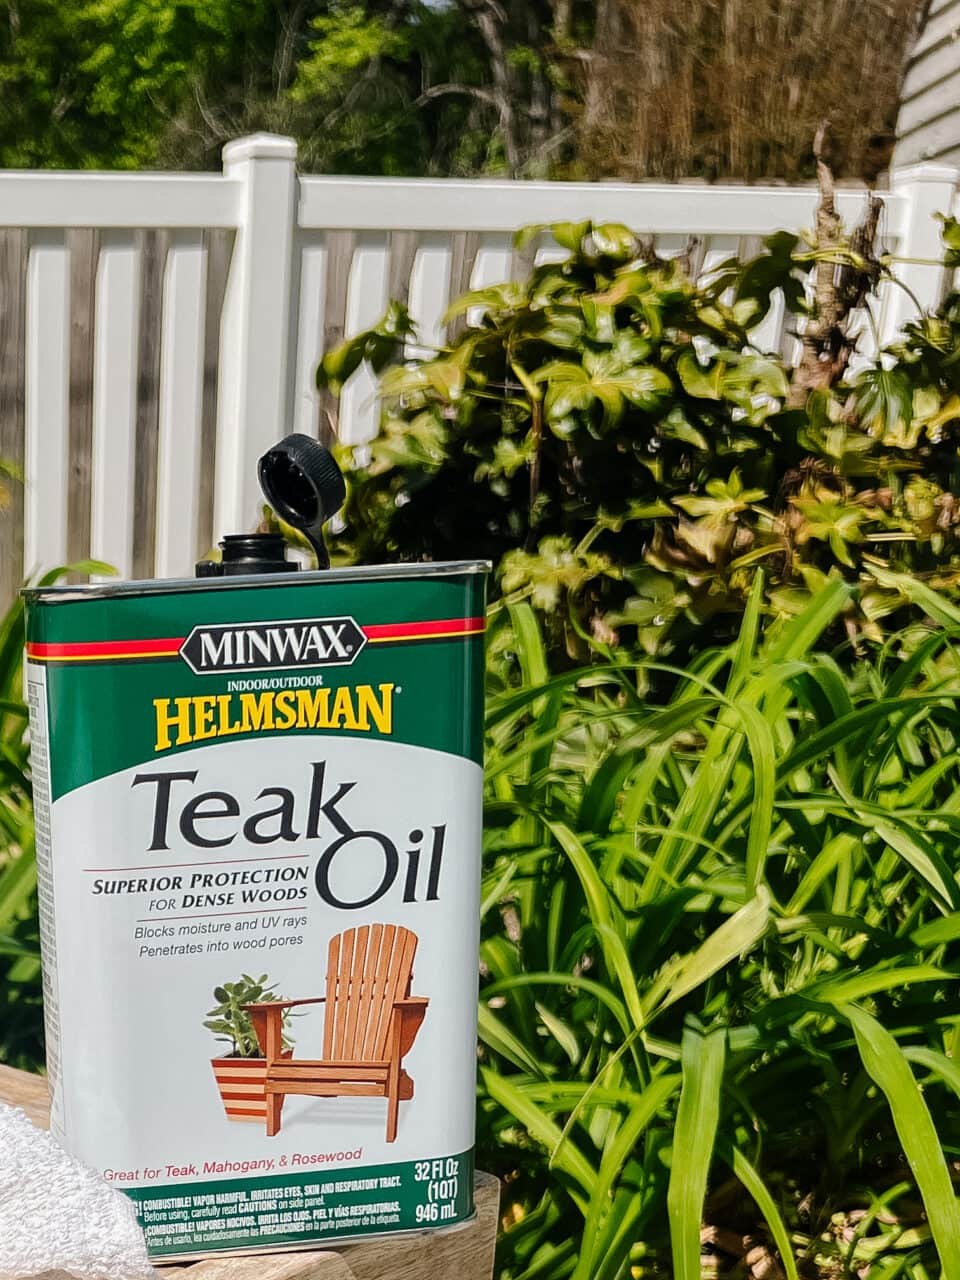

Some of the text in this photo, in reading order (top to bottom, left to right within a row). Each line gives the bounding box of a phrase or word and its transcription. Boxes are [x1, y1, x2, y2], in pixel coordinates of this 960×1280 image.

[200, 623, 347, 667] MINWAX
[227, 674, 323, 692] INDOOR/OUTDOOR
[153, 683, 394, 751] HELMSMAN
[131, 760, 357, 851] Teak
[92, 866, 309, 895] SUPERIOR PROTECTION
[315, 824, 446, 910] Oil
[148, 886, 308, 911] FOR DENSE WOODS
[134, 914, 308, 939] Blocks moisture and UV rays
[139, 935, 304, 958] Penetrates into wood pores
[103, 1147, 363, 1181] Great for Teak, Mahogany, & Rosewood
[414, 1158, 459, 1181] 32 Fl Oz
[416, 1199, 458, 1223] 946 mL
